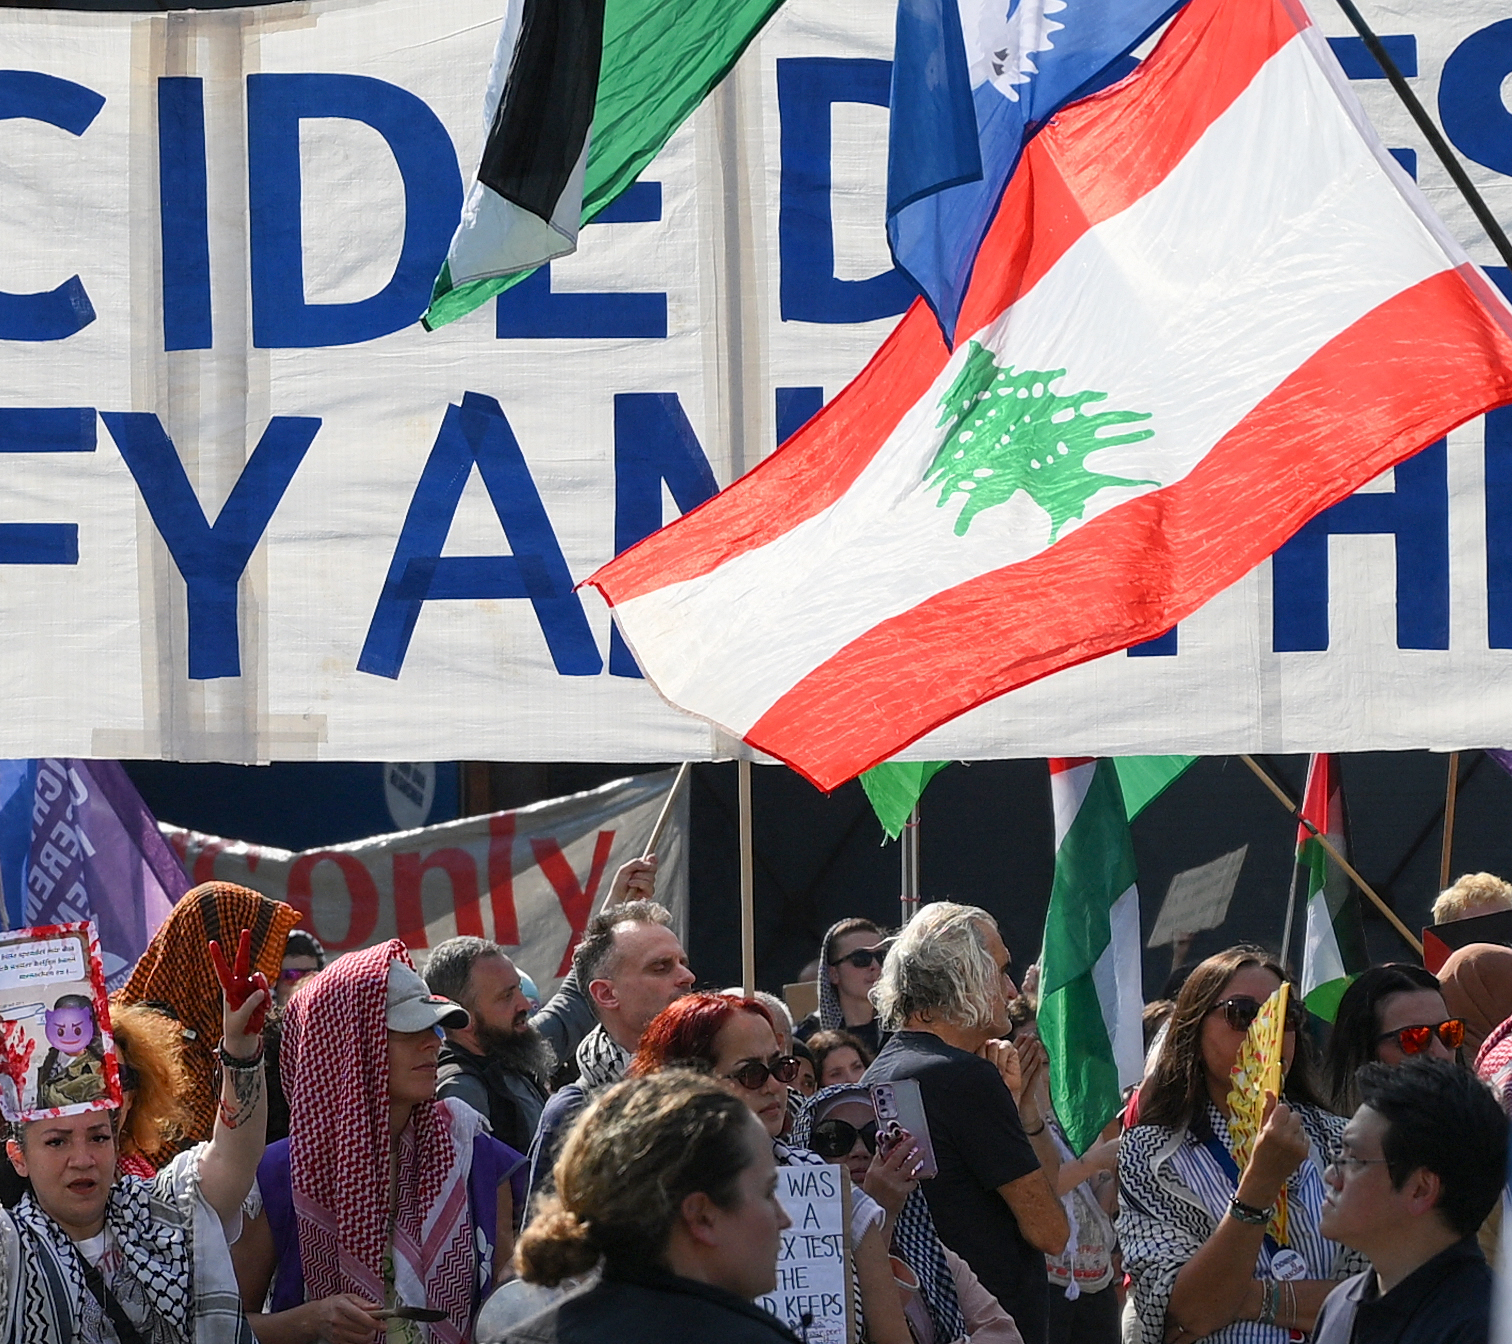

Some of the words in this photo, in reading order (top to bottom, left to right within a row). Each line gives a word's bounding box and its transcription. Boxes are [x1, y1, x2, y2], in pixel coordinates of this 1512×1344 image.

[787, 1170, 835, 1197] WAS
[803, 1202, 821, 1230] A
[800, 1233, 844, 1264] TEST,
[785, 1293, 843, 1318] KEEPS
